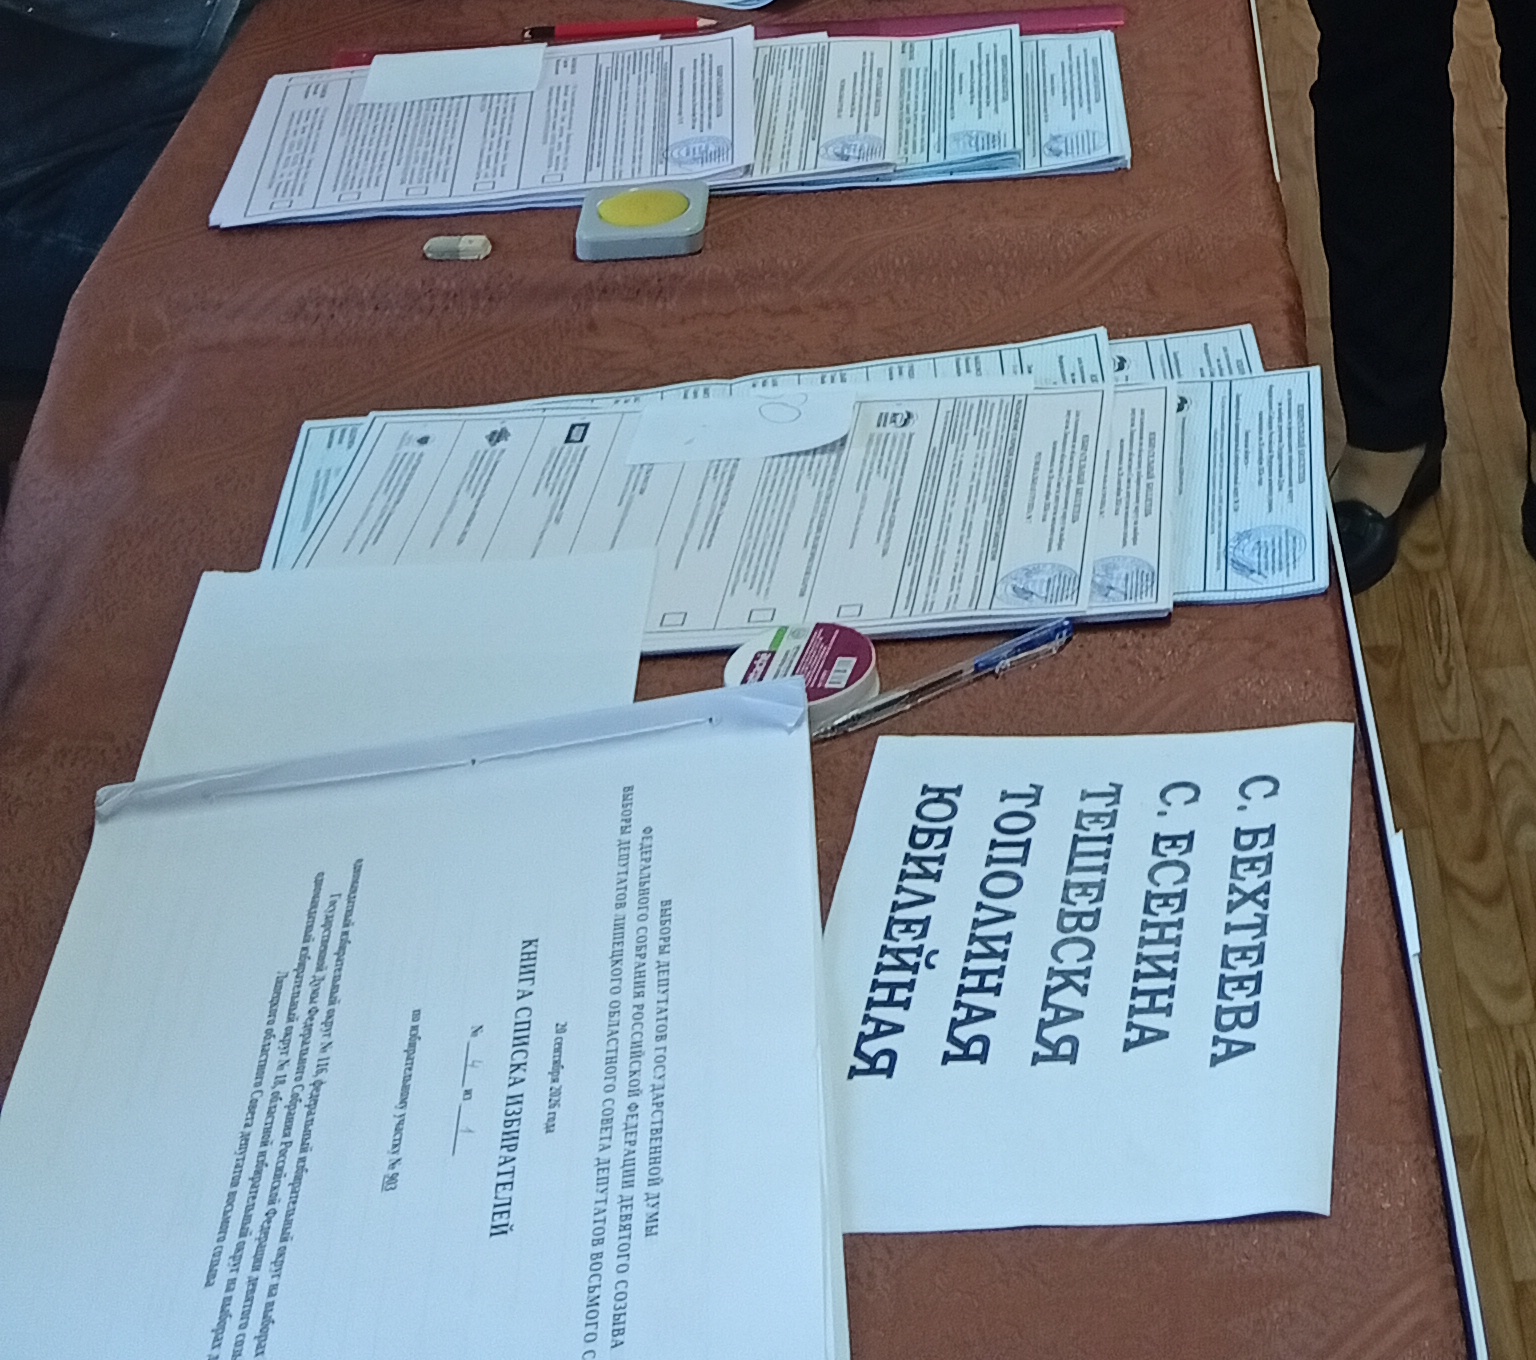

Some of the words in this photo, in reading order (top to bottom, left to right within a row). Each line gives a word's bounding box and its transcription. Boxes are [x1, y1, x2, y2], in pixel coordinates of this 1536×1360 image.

[619, 784, 635, 836] ВЫБОРЫ
[1156, 780, 1201, 817] С.
[1237, 774, 1280, 814] С.
[614, 838, 631, 910] ДЕПУТАТОВ
[636, 826, 653, 922] ФЕДЕРАЛЬНОГО
[609, 914, 626, 995] ЛИПЕЦКОГО
[632, 926, 648, 999] СОБРАНИЯ
[658, 898, 672, 956] ВЫБОРЫ
[847, 783, 963, 1082] ЮБИЛЕЙНАЯ
[940, 783, 1044, 1067] ТОПОЛИНАЯ
[1030, 782, 1123, 1067] ТЕШЕВСКАЯ
[1122, 830, 1194, 1054] ЕСЕНИНА
[1209, 824, 1277, 1069] БЕХТЕЕВА
[516, 937, 540, 1002] КНИГА
[654, 960, 670, 1043] ДЕПУТАТОВ
[507, 1006, 533, 1089] СПИСКА
[603, 999, 622, 1094] ОБЛАСТНОГО
[627, 1003, 645, 1098] РОССИЙСКОЙ
[598, 1097, 615, 1153] СОВЕТА
[621, 1102, 639, 1190] ФЕДЕРАЦИИ
[647, 1045, 668, 1187] ГОСУДАРСТВЕННОЙ
[489, 1092, 525, 1239] ИЗБИРАТЕЛЕЙ
[591, 1156, 611, 1247] ДЕПУТАТОВ
[615, 1194, 634, 1274] ДЕВЯТОГО
[644, 1192, 660, 1238] ДУМЫ
[583, 1251, 604, 1344] ВОСЬМОГО
[610, 1279, 629, 1349] СОЗЫВА
